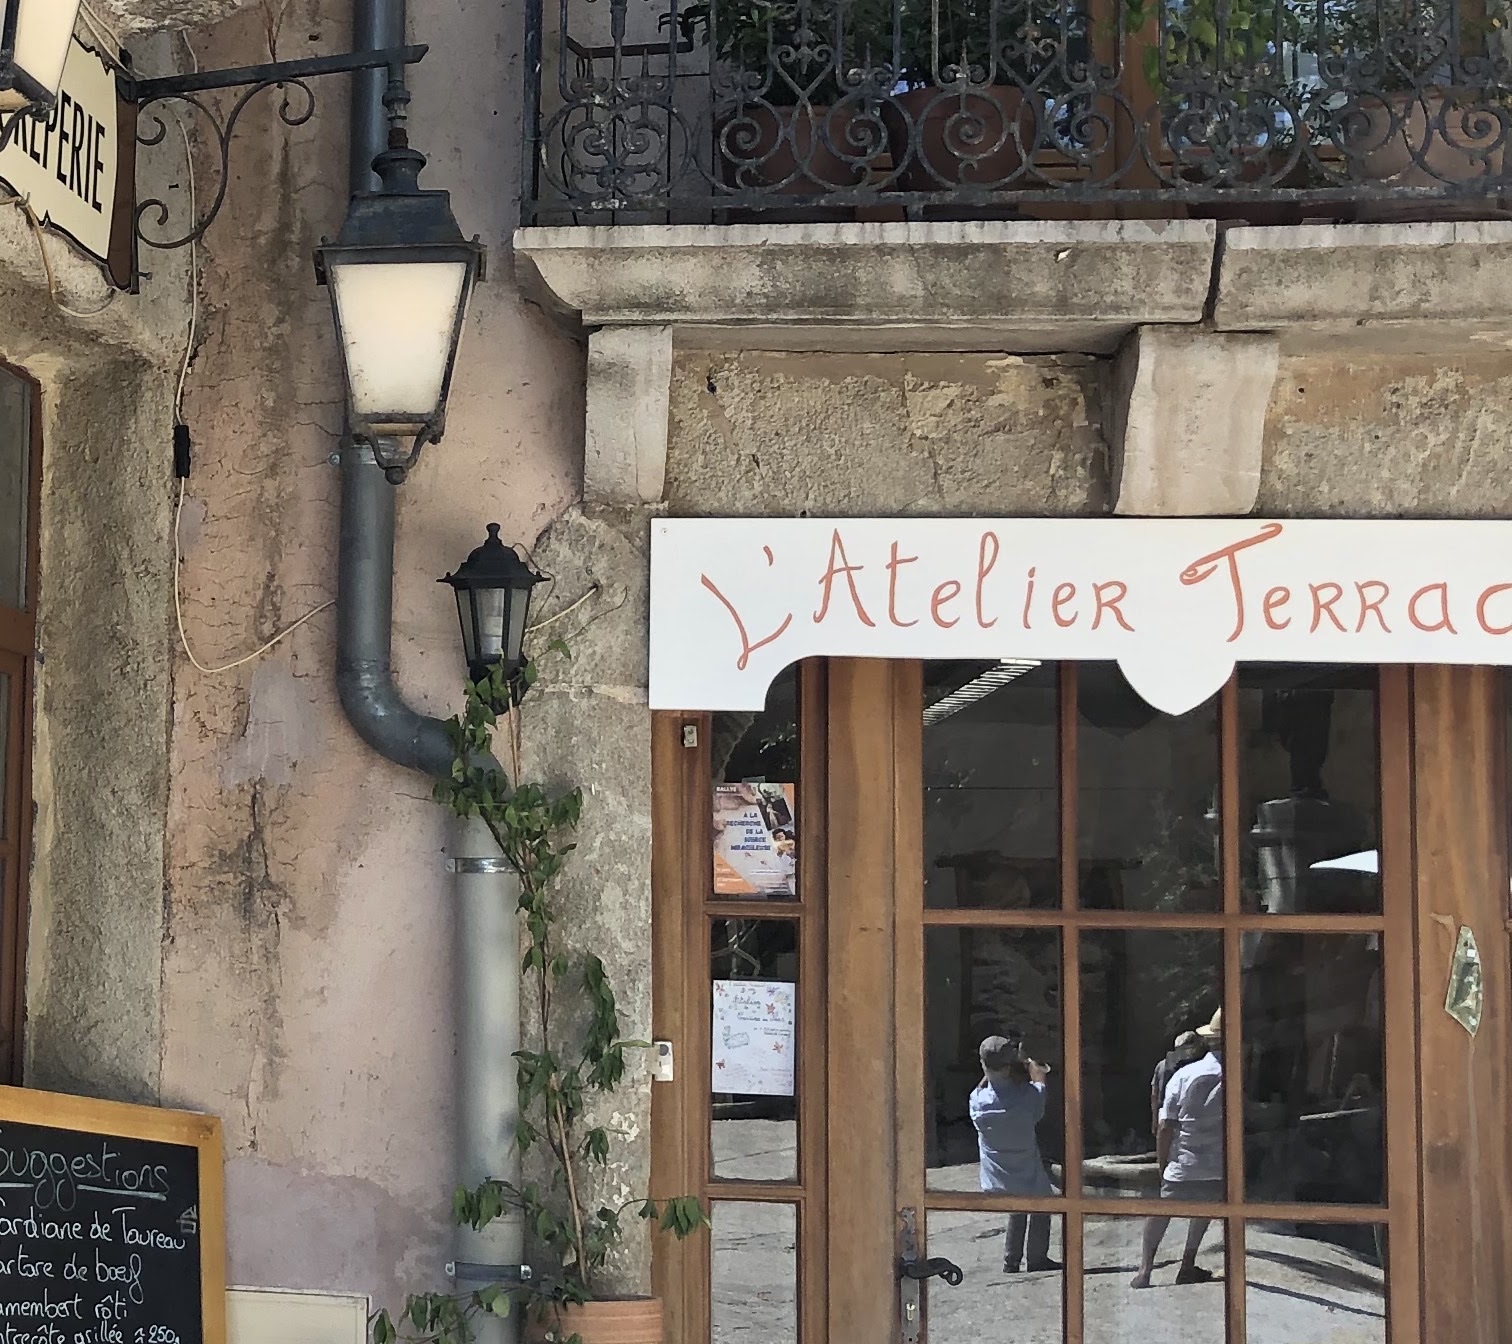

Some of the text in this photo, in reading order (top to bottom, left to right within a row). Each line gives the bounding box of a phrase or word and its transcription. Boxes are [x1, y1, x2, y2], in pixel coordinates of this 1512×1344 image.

[89, 1211, 113, 1242] de
[111, 1207, 186, 1250] Taureau
[63, 1252, 88, 1281] de
[94, 1291, 128, 1320] rôti
